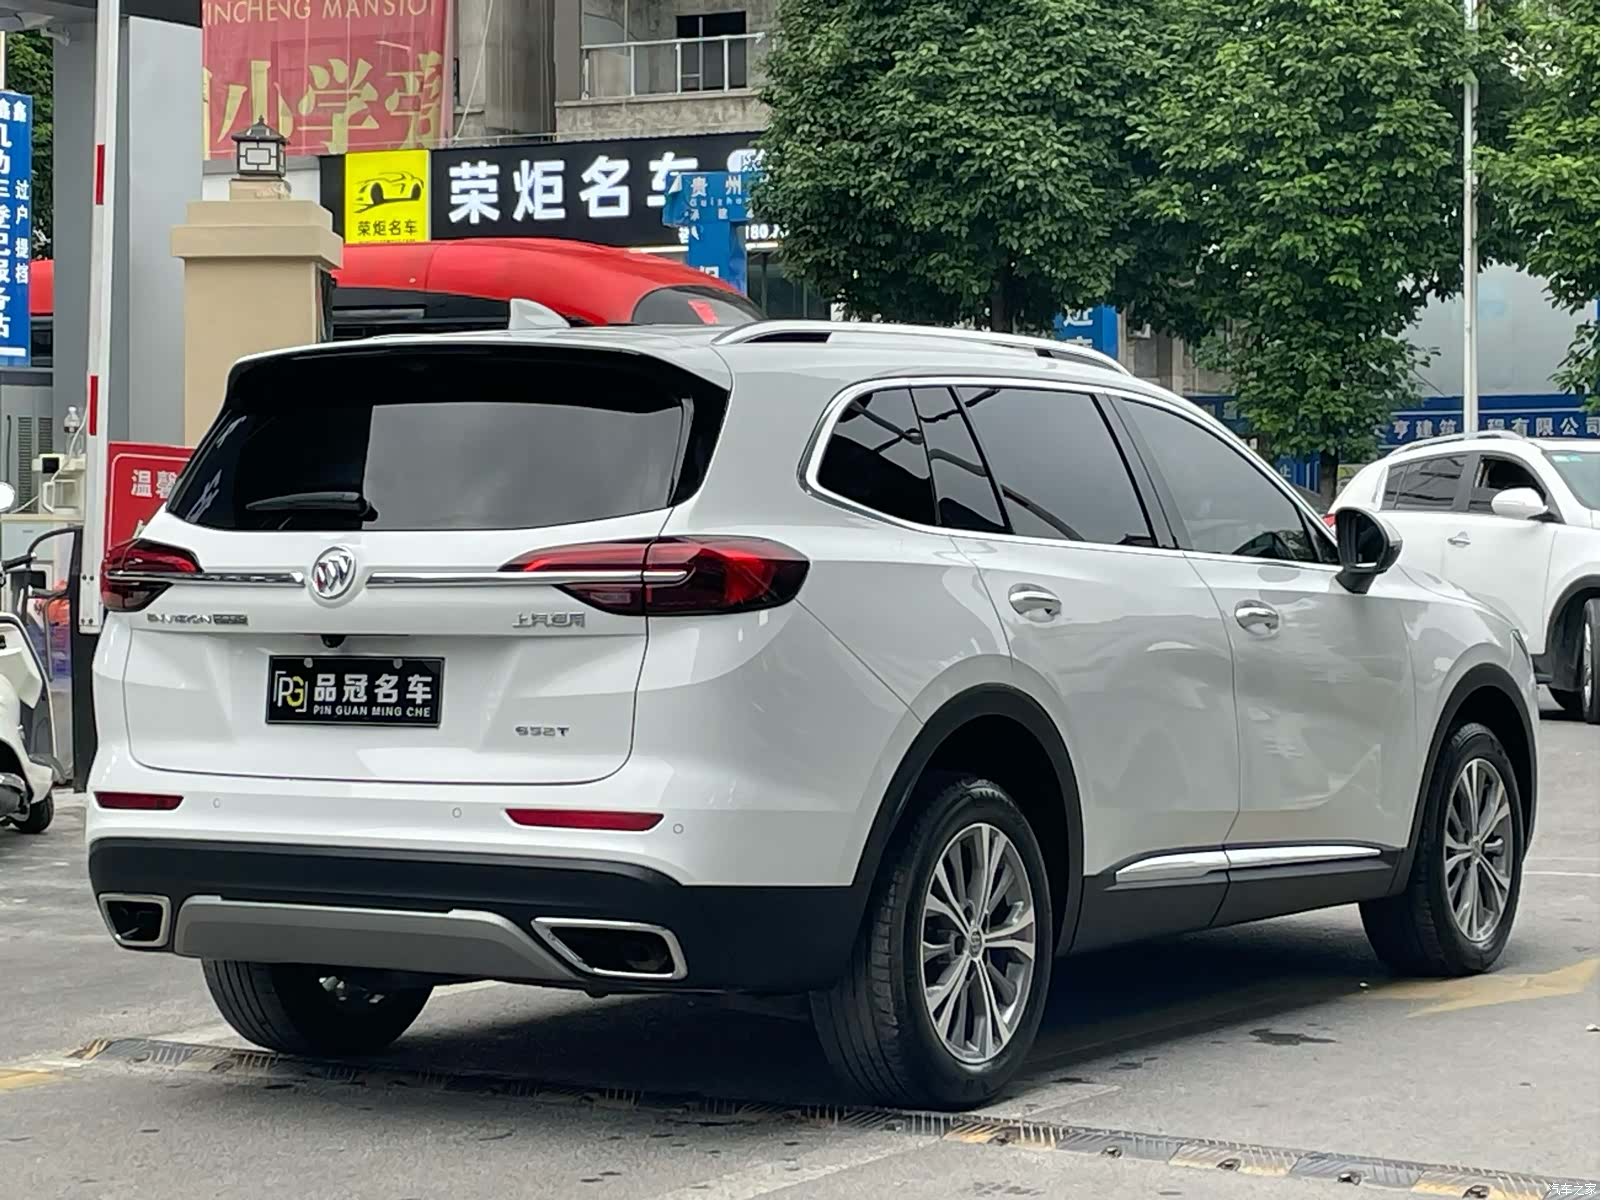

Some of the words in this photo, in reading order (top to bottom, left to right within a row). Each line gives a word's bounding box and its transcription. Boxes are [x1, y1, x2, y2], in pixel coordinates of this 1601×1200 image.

[357, 219, 418, 237] 荣炬名车
[313, 673, 433, 704] 品冠名车
[313, 704, 332, 715] PIN
[335, 705, 368, 716] GUAN
[371, 706, 402, 717] MING
[406, 707, 431, 718] CHE
